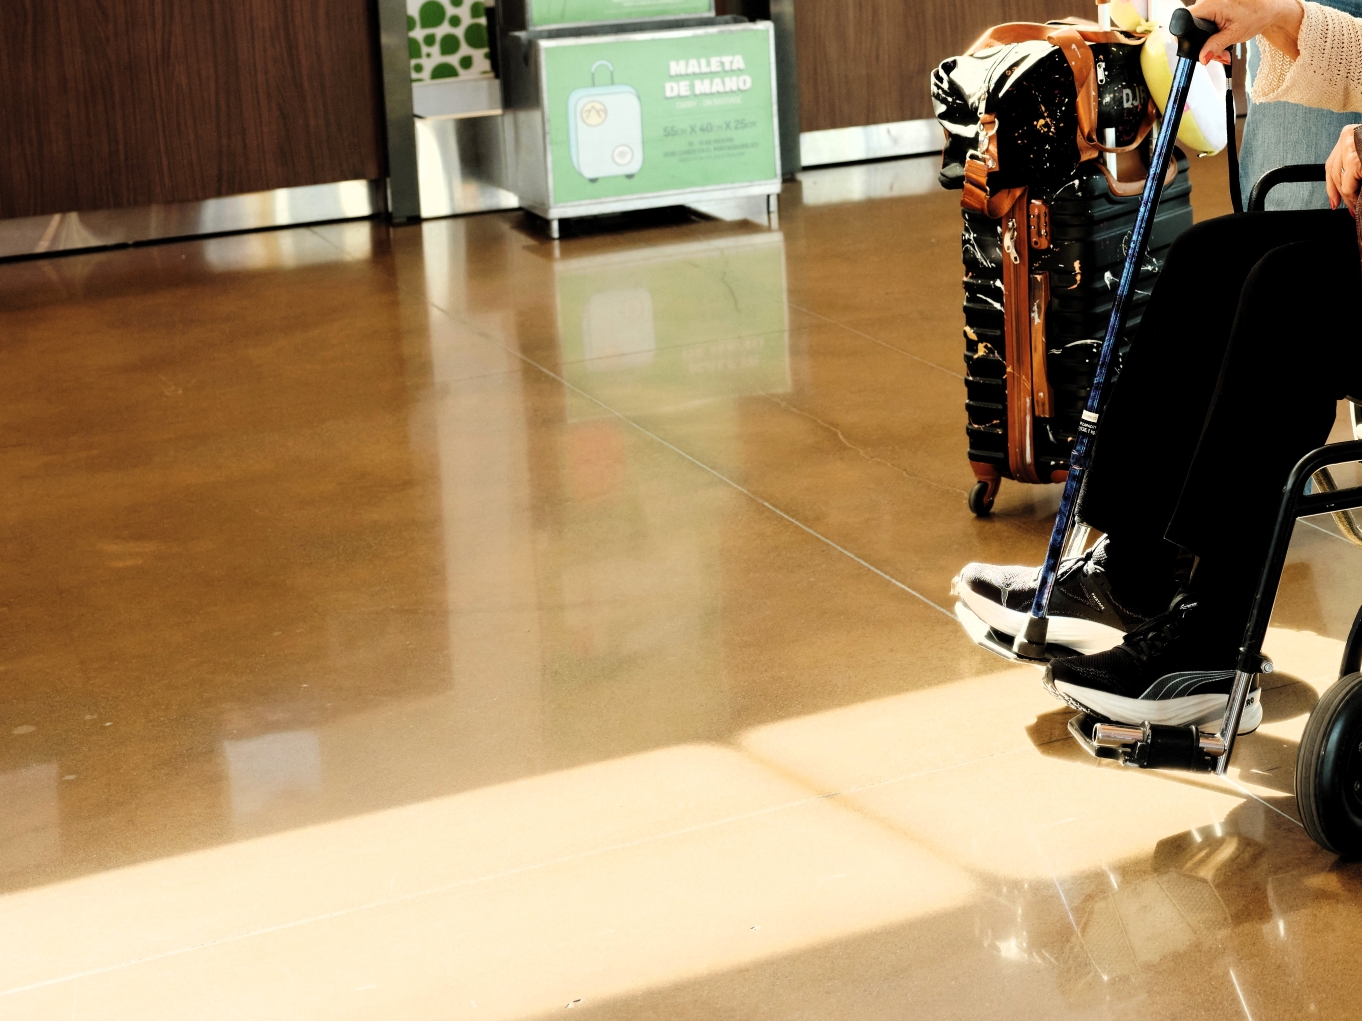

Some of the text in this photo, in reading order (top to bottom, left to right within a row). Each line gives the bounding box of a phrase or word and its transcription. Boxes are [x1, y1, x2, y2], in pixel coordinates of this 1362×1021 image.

[669, 54, 745, 76] MALETA
[664, 74, 752, 98] DE MANO
